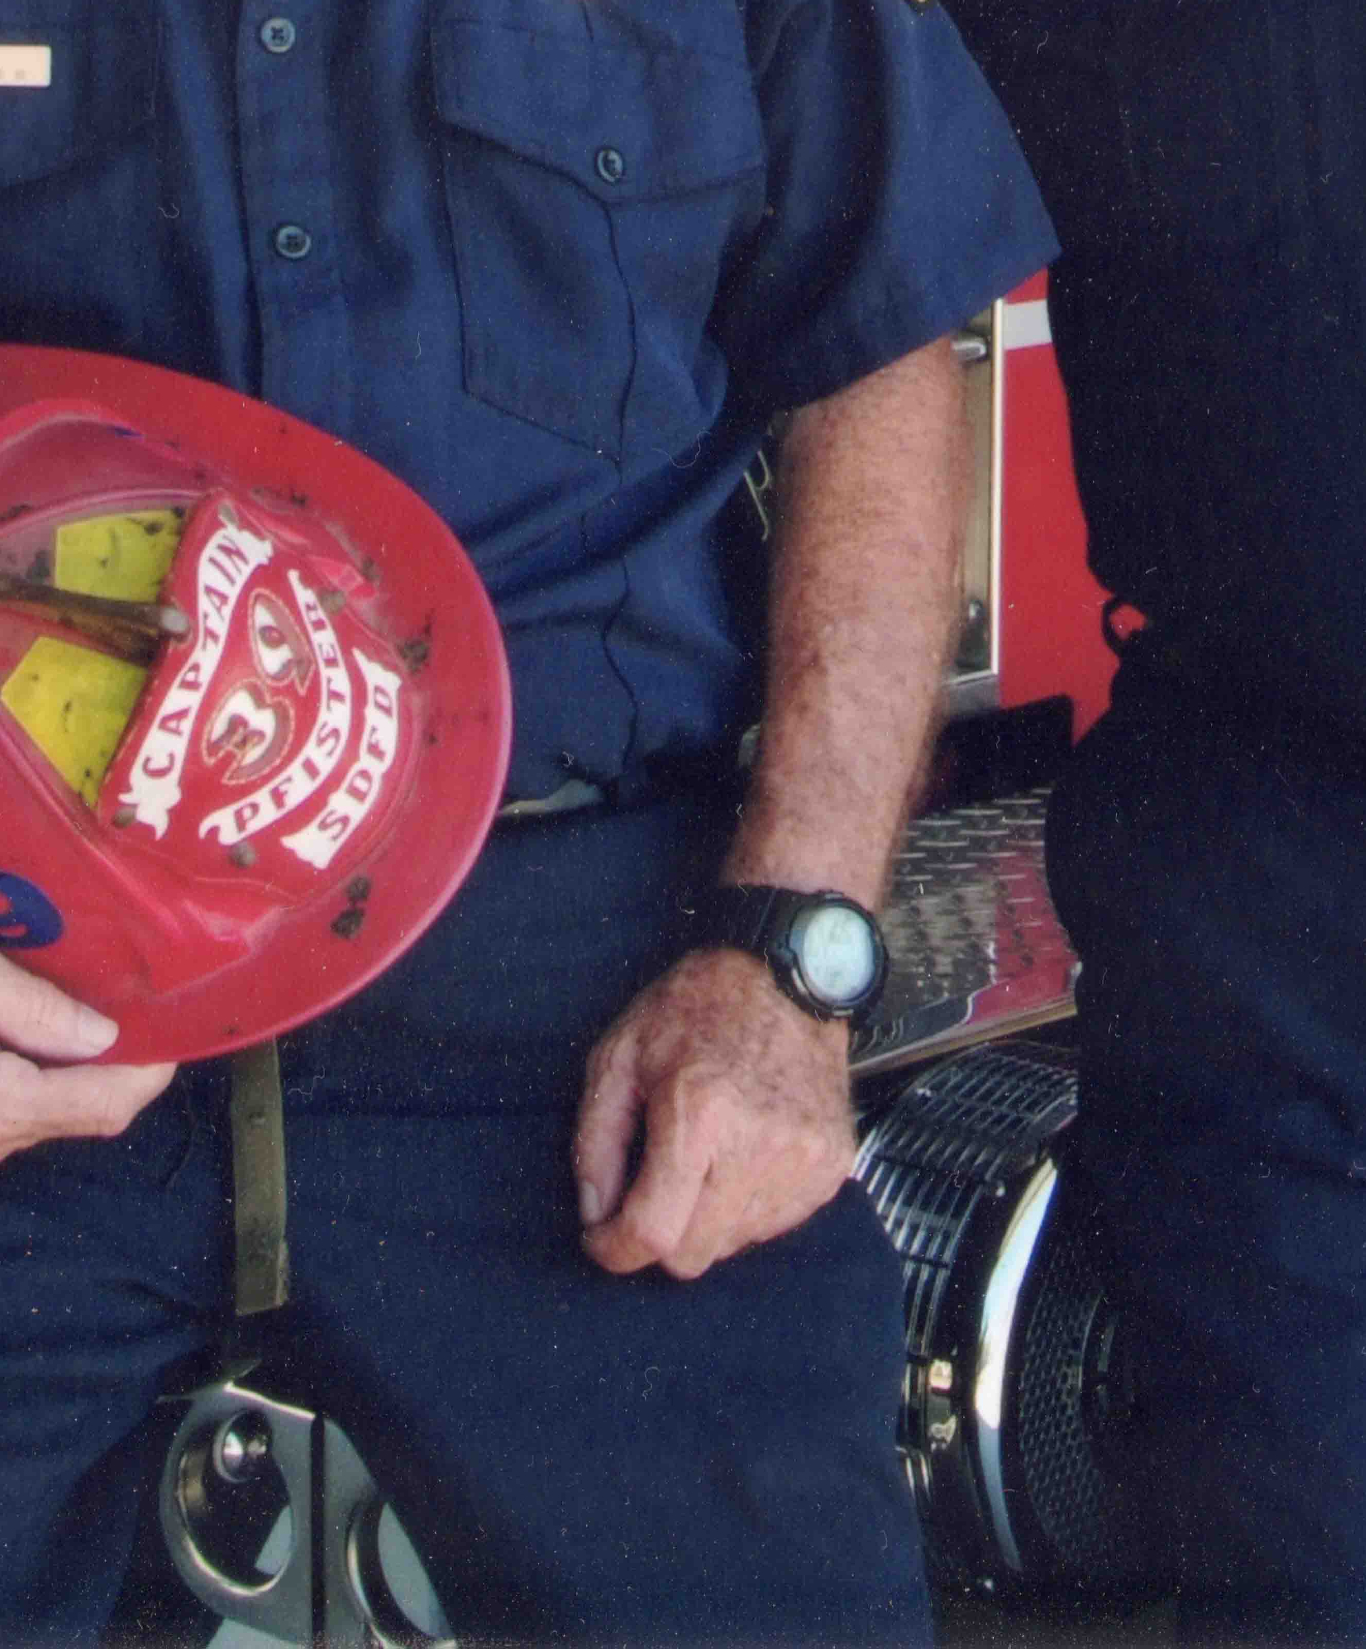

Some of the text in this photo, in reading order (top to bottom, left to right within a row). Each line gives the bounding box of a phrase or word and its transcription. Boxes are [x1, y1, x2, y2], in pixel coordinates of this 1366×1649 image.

[141, 531, 248, 781] CAPTAIN
[233, 595, 347, 835] PFISTER
[319, 683, 394, 842] SDFD
